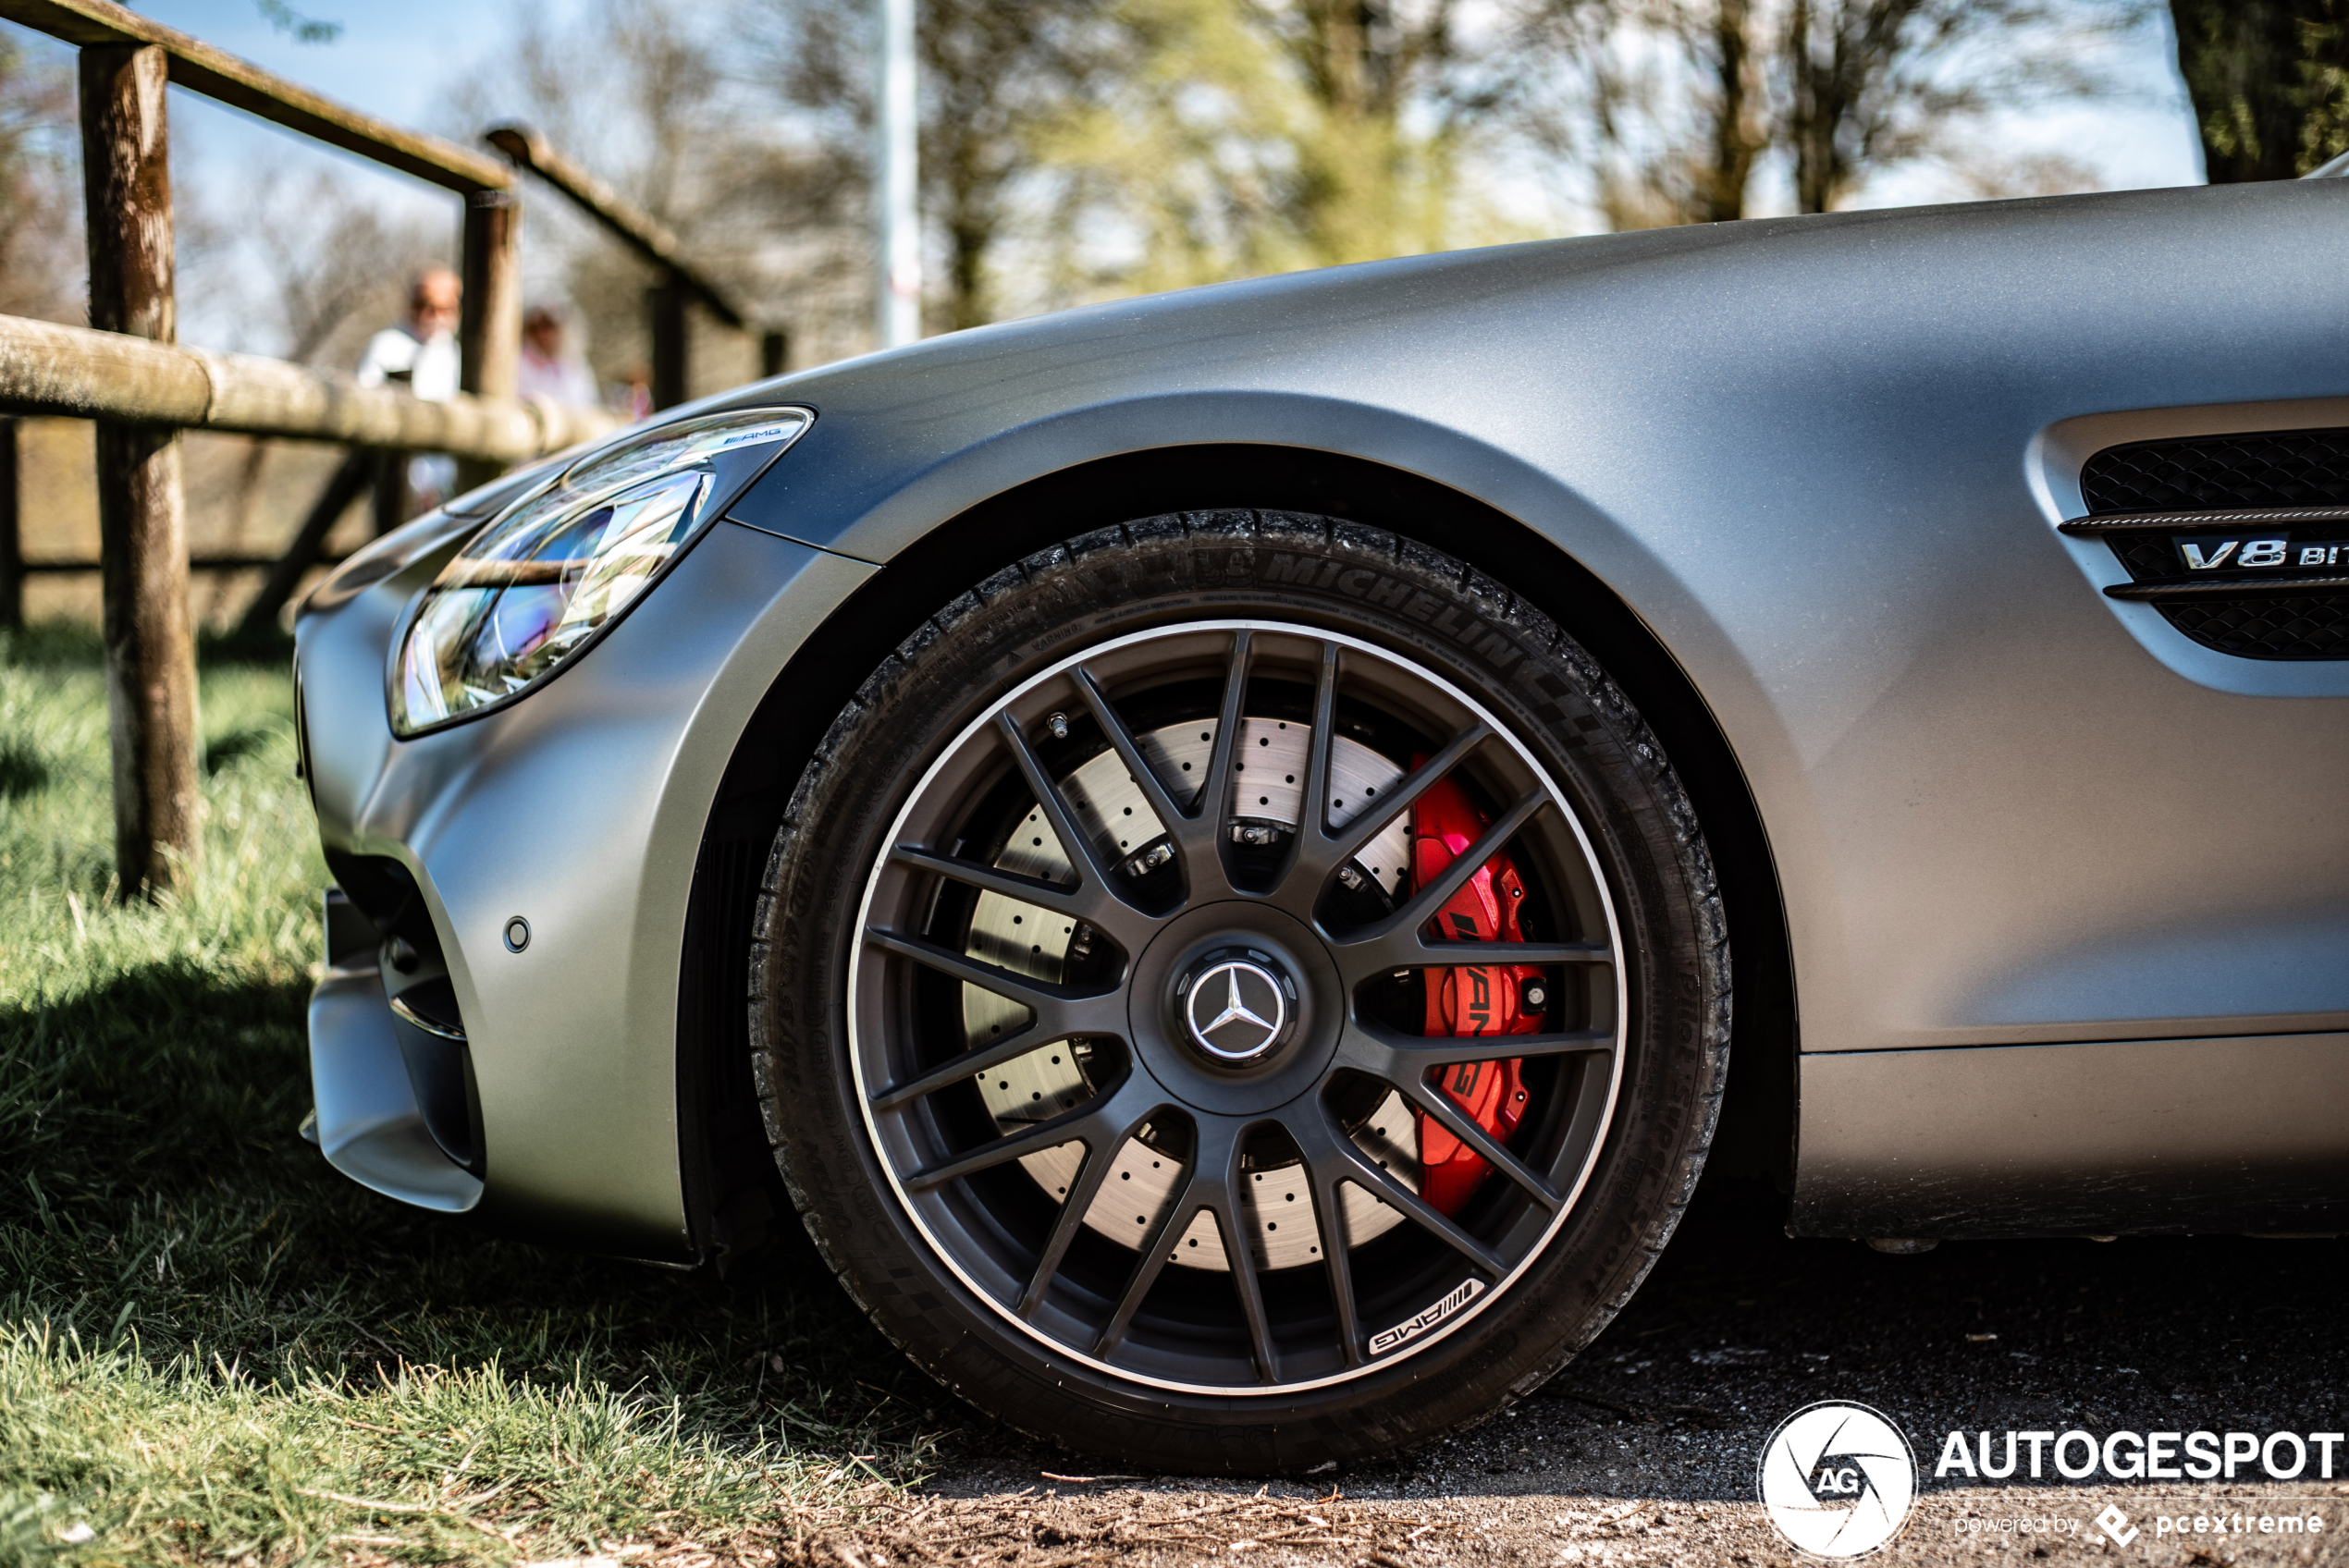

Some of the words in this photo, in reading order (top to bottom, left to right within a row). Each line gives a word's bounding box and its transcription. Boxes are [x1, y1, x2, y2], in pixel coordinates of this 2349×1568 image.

[2183, 540, 2287, 570] V8
[968, 596, 1035, 641] TEMPERATURE
[1262, 552, 1524, 669] MICHELIN
[1650, 970, 1662, 1041] TUBELESS
[1675, 970, 1698, 1063] Pilot
[1639, 1049, 1660, 1112] MICHELIN
[1636, 1077, 1692, 1192] Super
[1612, 1153, 1646, 1201] MO
[1572, 1197, 1653, 1303] Sport
[1374, 1304, 1442, 1349] AMG
[948, 1341, 1207, 1459] MICHELIN
